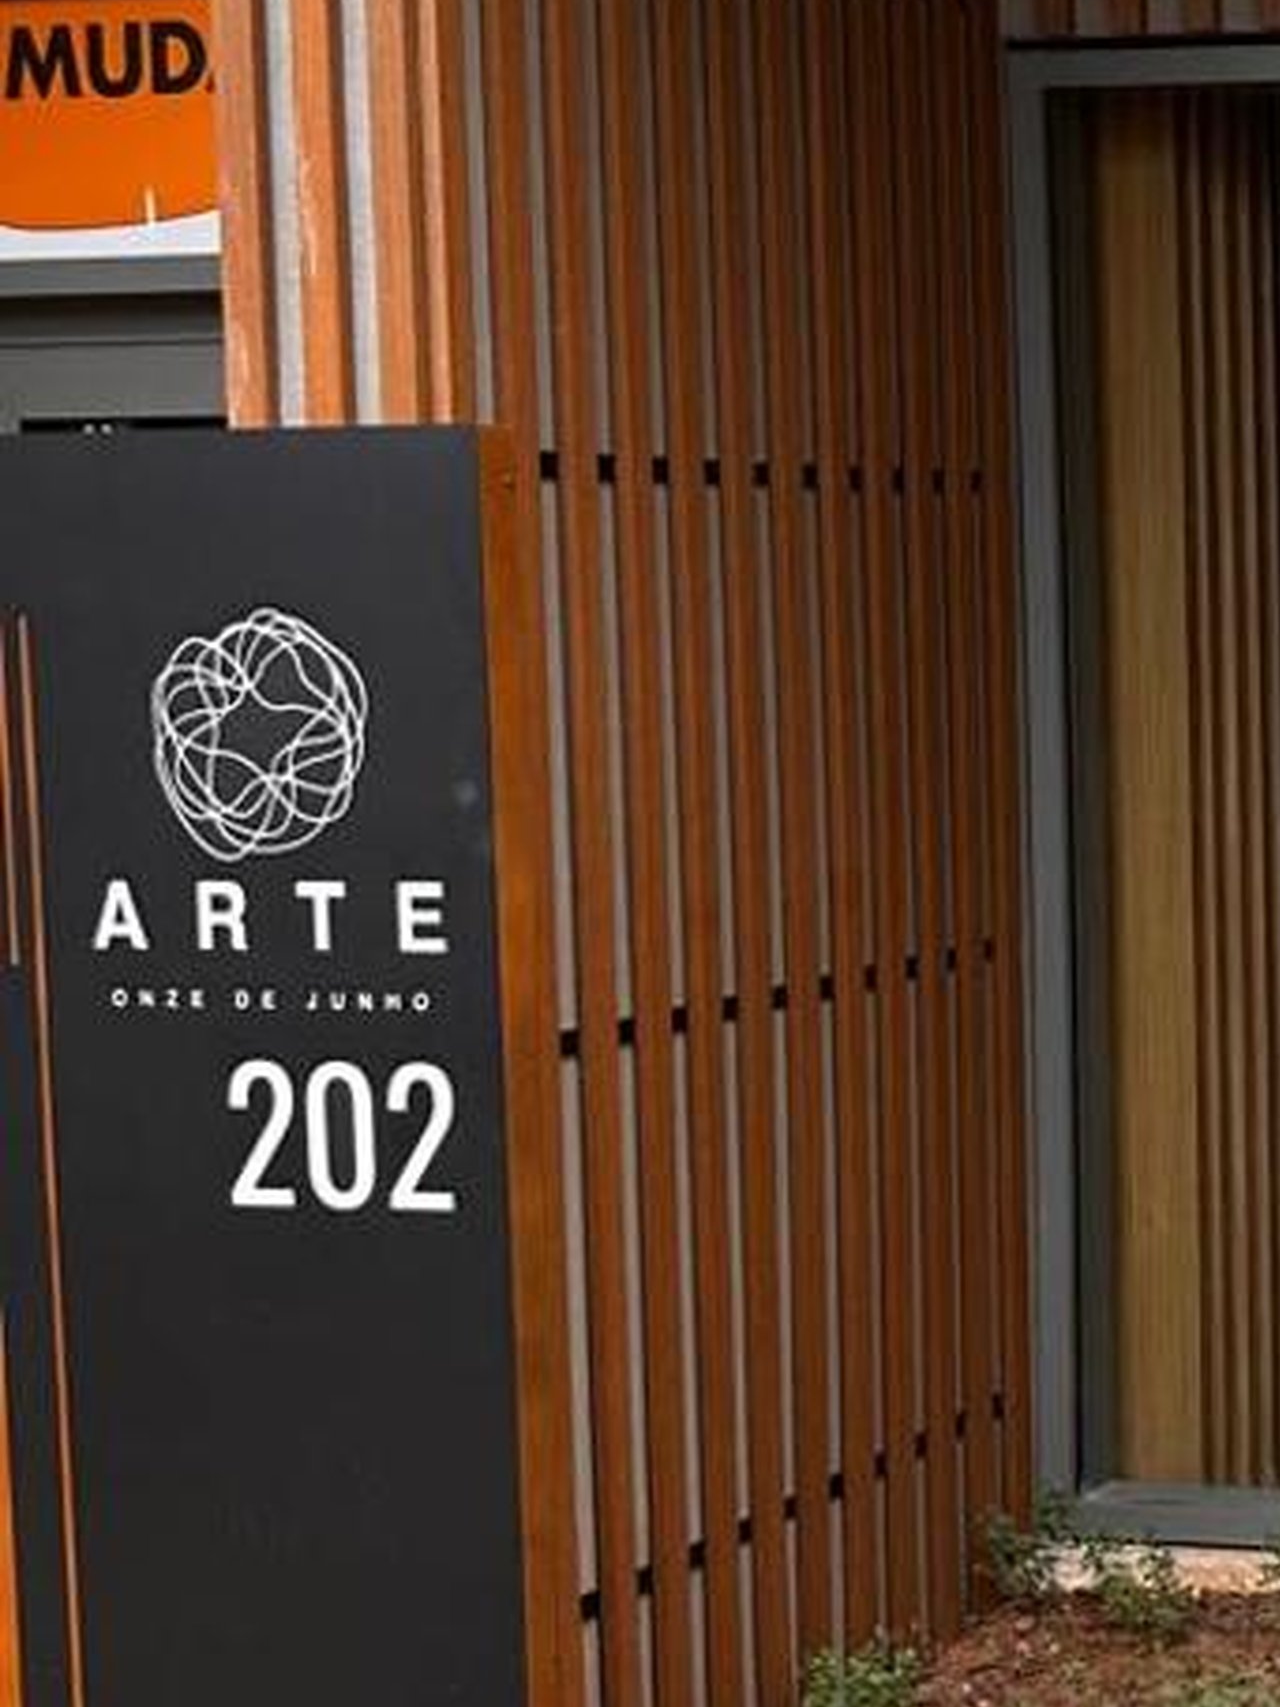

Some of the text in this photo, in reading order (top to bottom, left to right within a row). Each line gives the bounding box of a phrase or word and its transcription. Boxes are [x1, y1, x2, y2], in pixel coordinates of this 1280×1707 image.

[7, 20, 214, 100] MUD
[94, 878, 449, 954] ARTE
[111, 988, 431, 1012] ONZE DE JUNHO
[227, 1059, 457, 1212] 202
